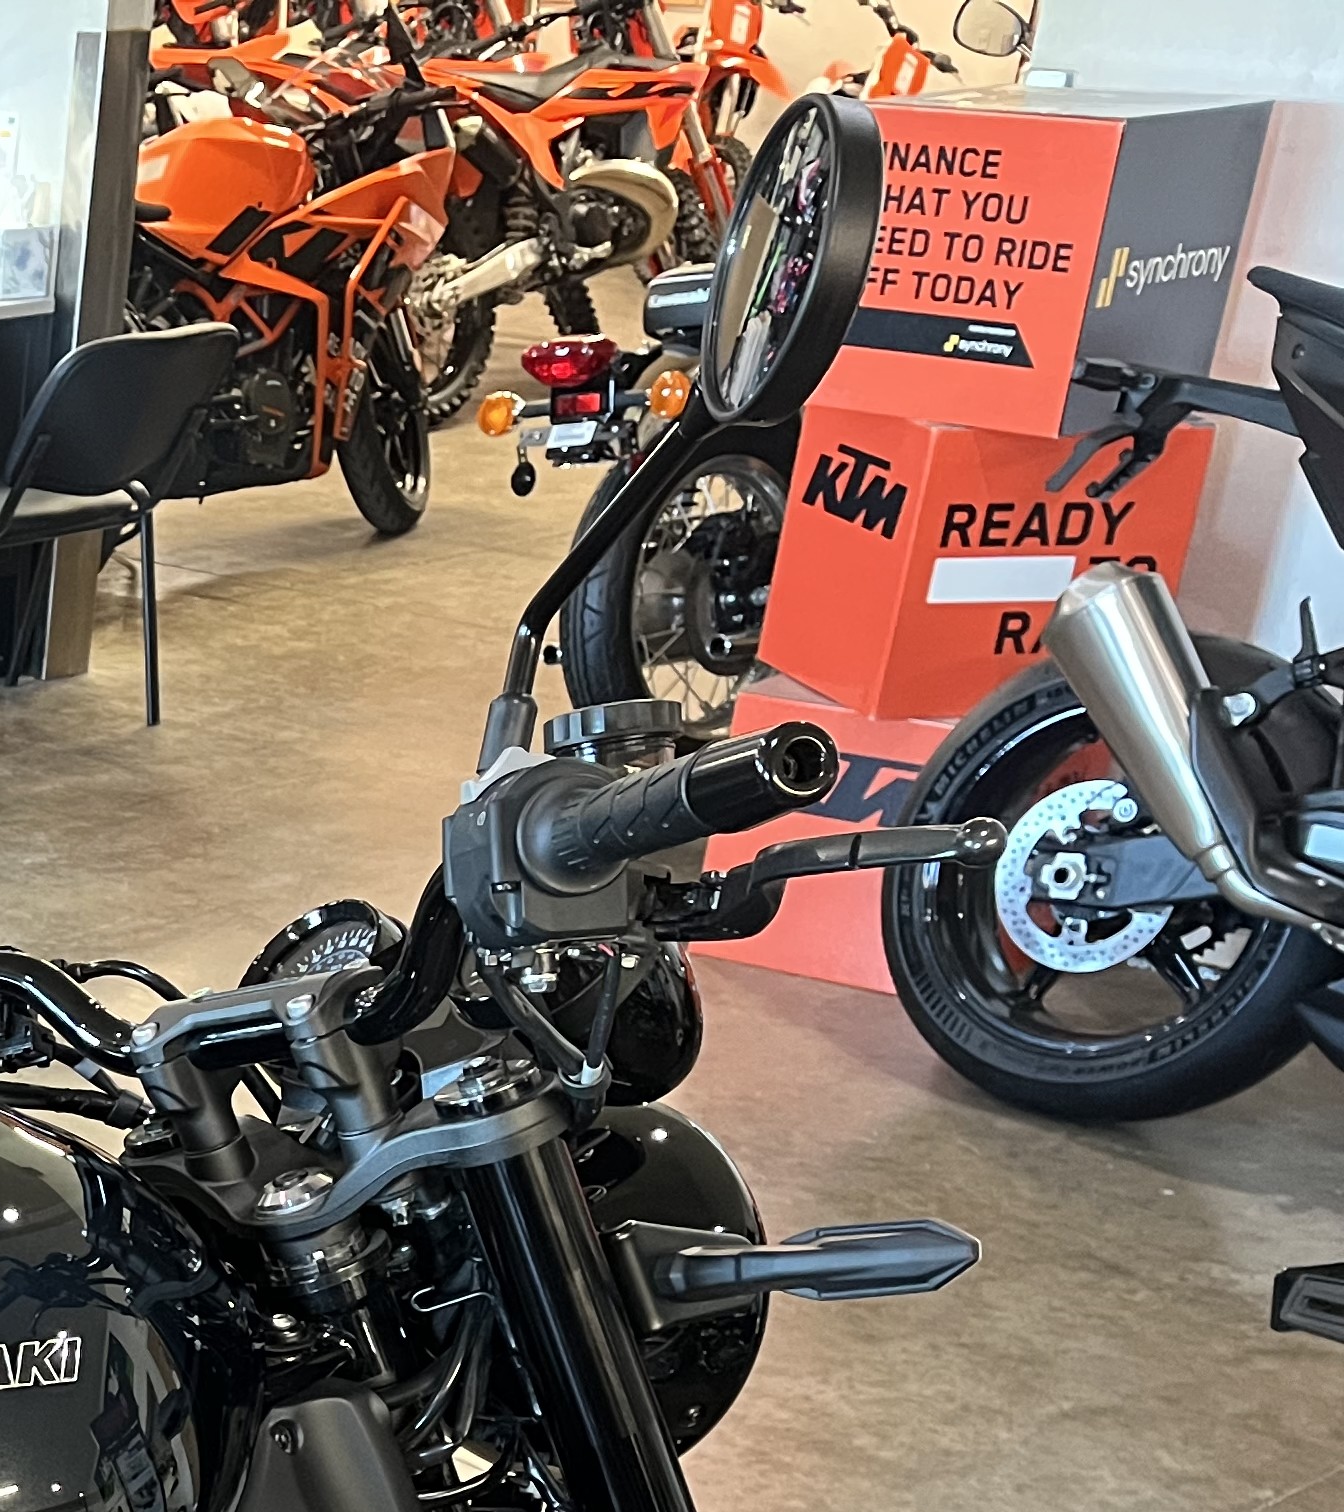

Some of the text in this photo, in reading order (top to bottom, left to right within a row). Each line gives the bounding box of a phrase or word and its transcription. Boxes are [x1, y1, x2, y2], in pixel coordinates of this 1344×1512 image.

[883, 141, 1002, 180] NANCE
[883, 184, 1029, 225] HAT YOU
[875, 225, 1073, 273] ED TO RIDE
[1125, 243, 1231, 296] synchrony
[912, 271, 1024, 310] TODAY
[801, 443, 908, 540] KTM
[939, 501, 1136, 549] READY
